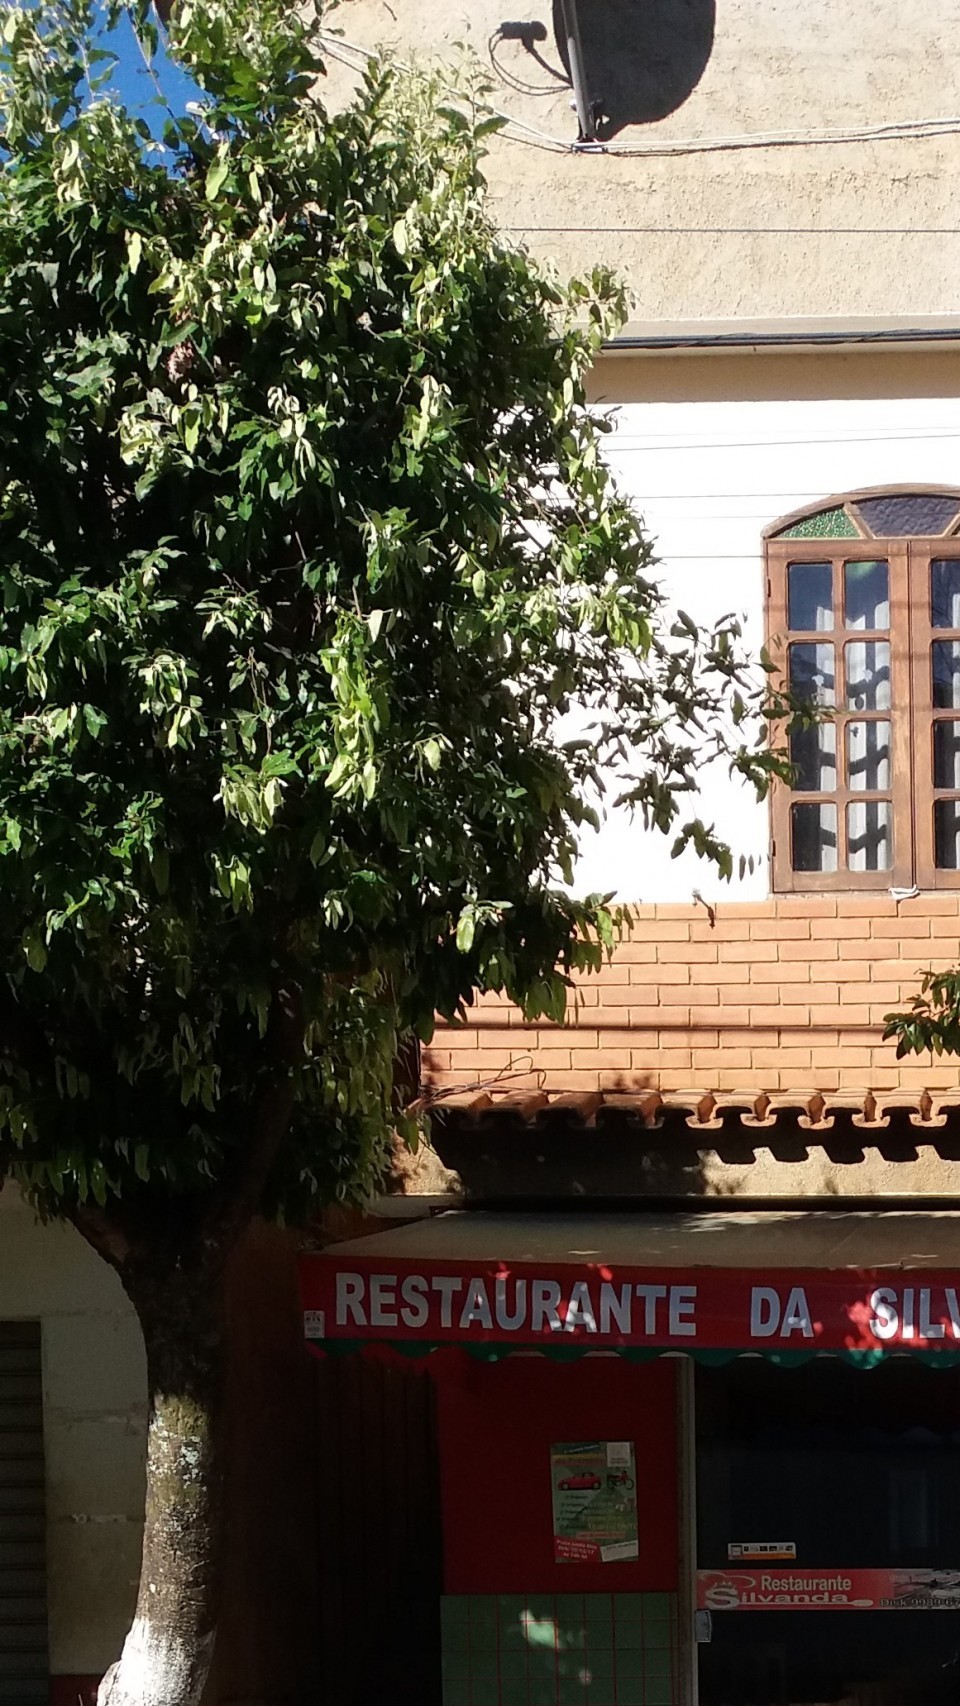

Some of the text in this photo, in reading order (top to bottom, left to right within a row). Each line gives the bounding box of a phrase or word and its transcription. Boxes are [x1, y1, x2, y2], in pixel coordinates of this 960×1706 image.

[334, 1271, 698, 1337] RESTAURANTE
[750, 1286, 814, 1338] DA
[760, 1575, 852, 1592] Restaurante
[704, 1587, 848, 1609] Silvanda
